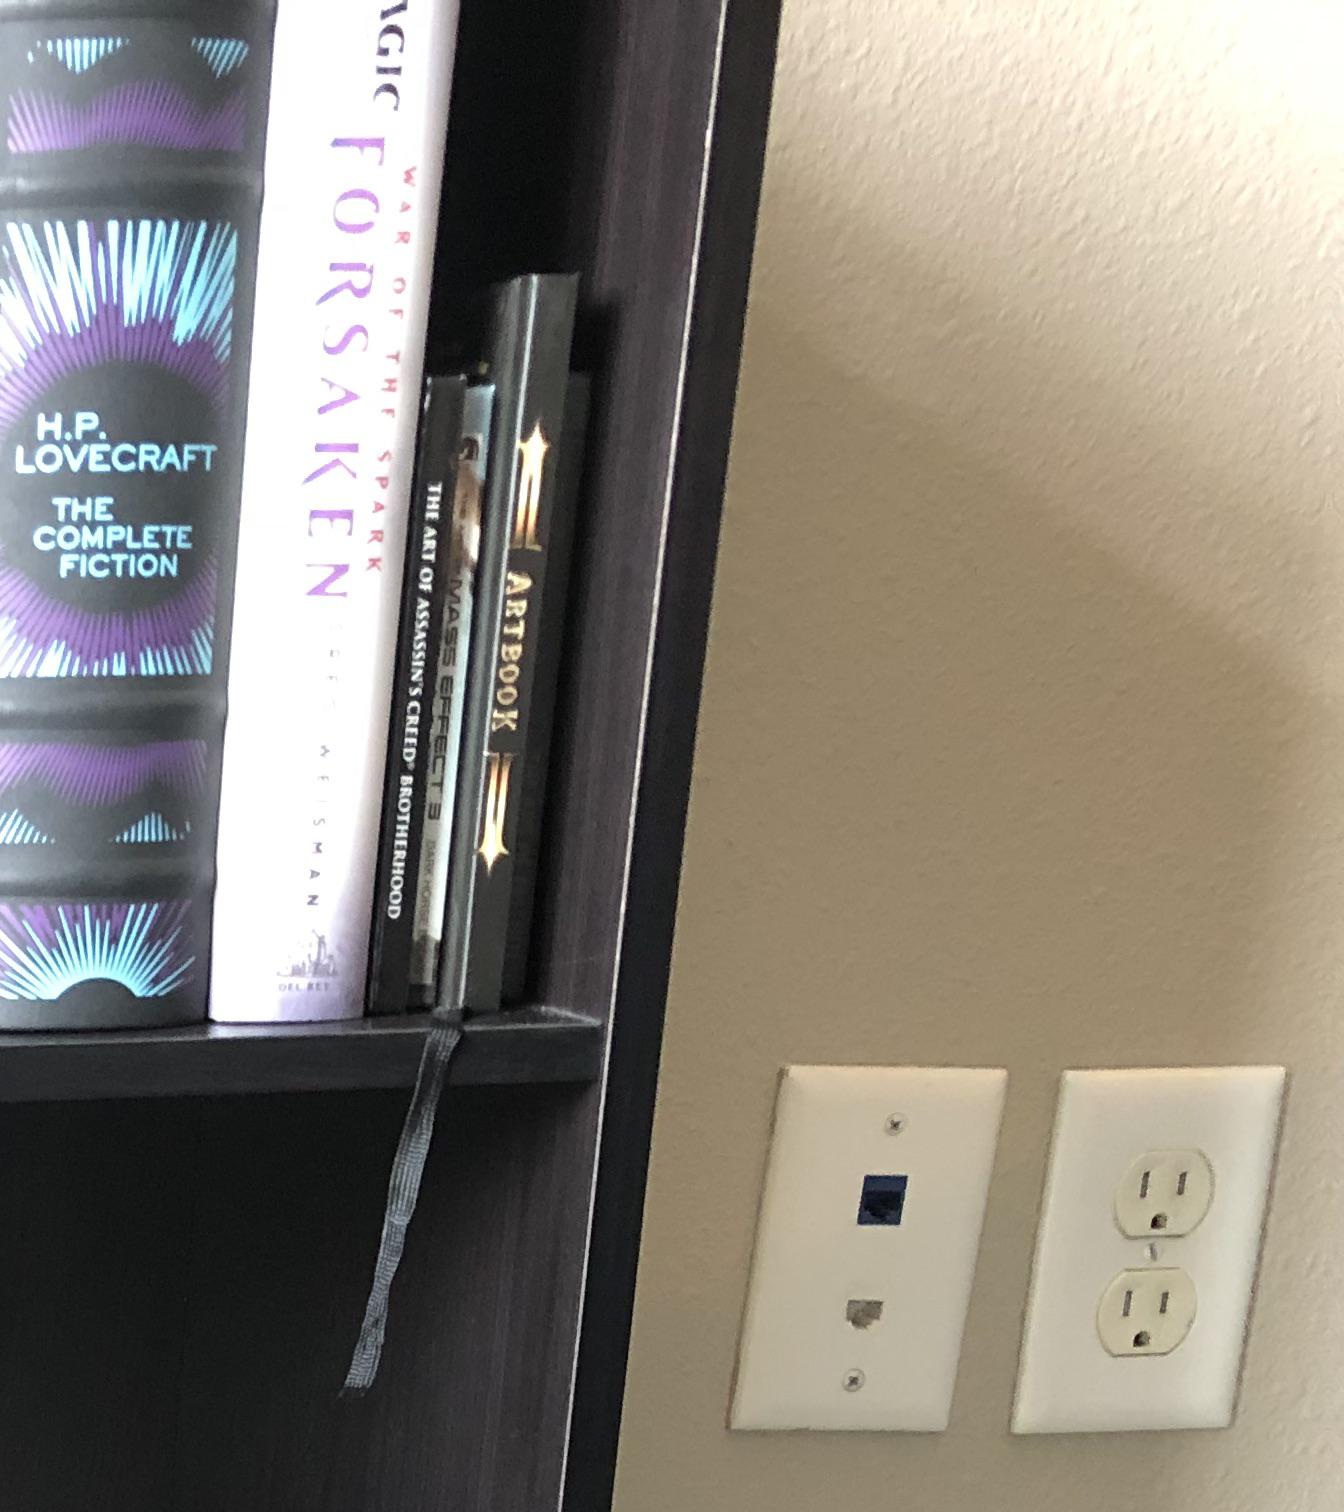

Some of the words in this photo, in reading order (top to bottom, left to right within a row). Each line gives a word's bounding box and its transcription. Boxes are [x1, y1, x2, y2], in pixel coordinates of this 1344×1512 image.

[302, 136, 386, 599] FORSAKEN
[36, 413, 107, 440] H.P.
[15, 444, 217, 474] LOVECRAFT
[52, 496, 114, 521] THE
[425, 481, 442, 521] THE
[33, 525, 192, 551] COMPLETE
[421, 525, 439, 565] ART
[59, 555, 178, 578] FICTION
[418, 567, 434, 594] OF
[441, 578, 464, 668] MASS
[491, 570, 533, 732] ARTBOOK
[430, 673, 455, 795] EFFECT
[428, 801, 442, 821] 3
[387, 775, 413, 920] BROTHERHOOD
